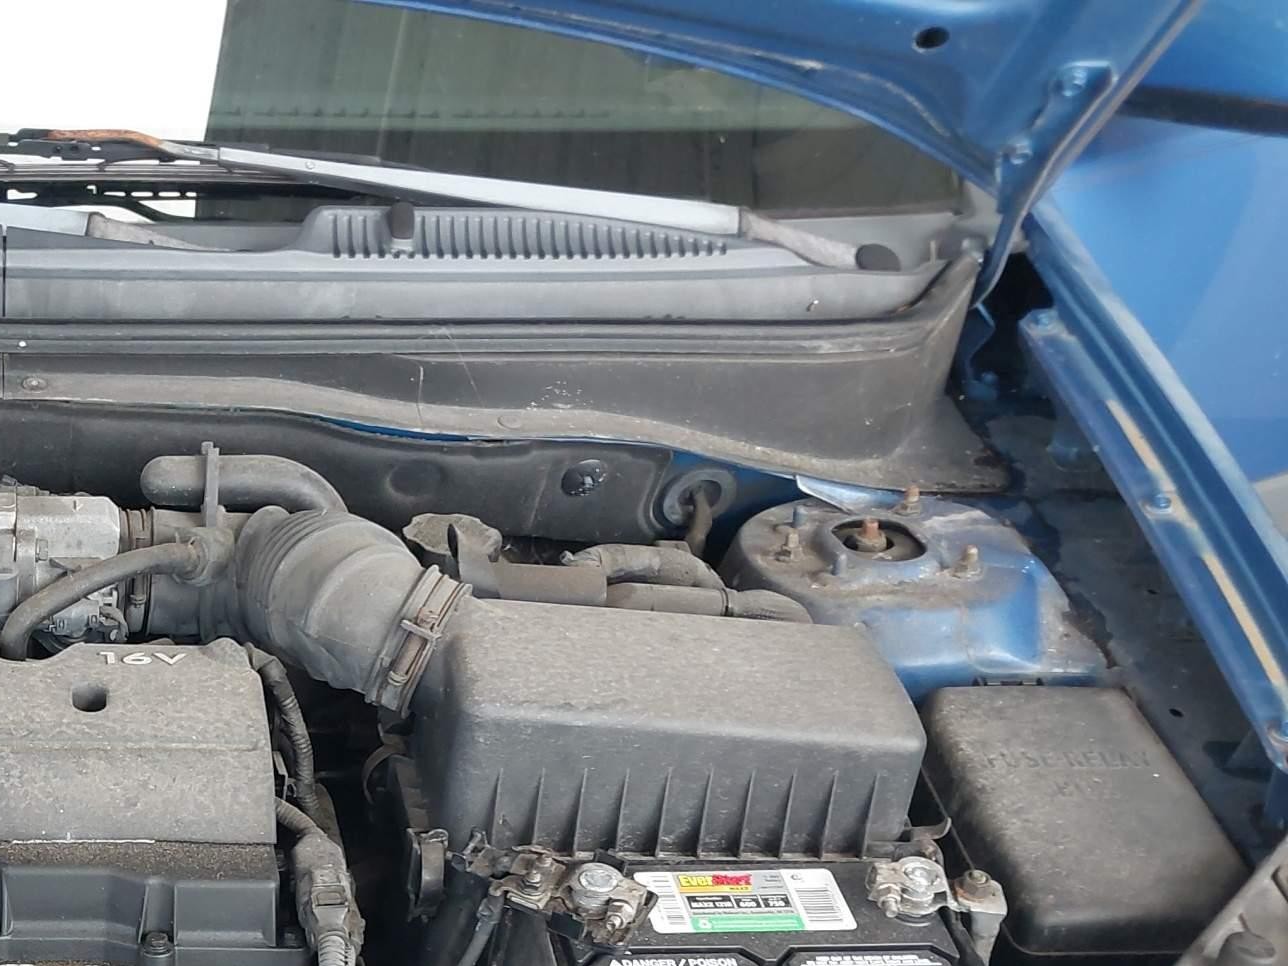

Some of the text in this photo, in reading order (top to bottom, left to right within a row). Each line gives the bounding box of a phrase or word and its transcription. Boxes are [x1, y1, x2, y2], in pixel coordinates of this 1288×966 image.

[96, 651, 188, 665] 16V
[622, 959, 677, 966] DANGER
[688, 958, 737, 966] POISON
